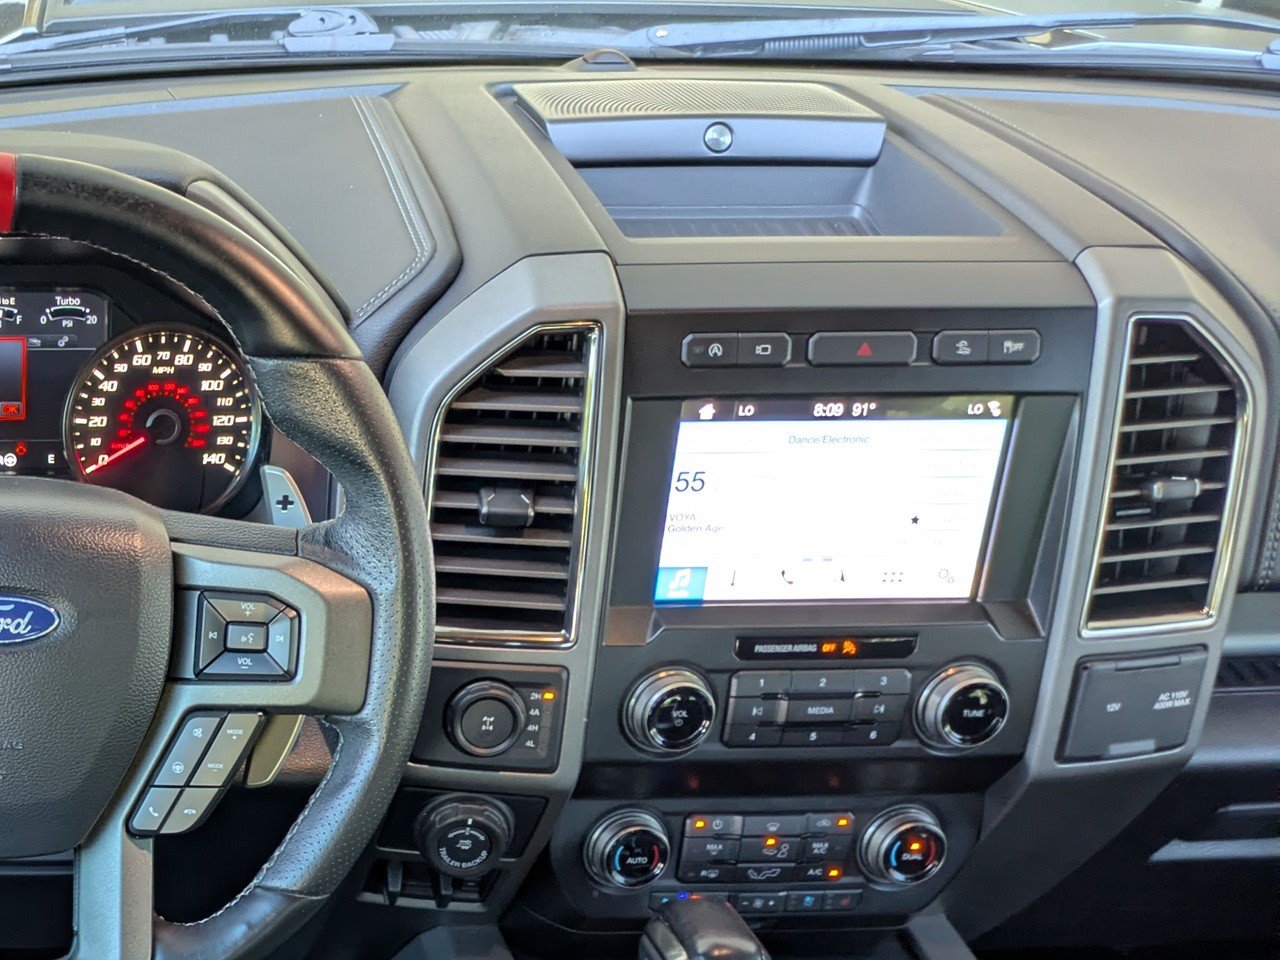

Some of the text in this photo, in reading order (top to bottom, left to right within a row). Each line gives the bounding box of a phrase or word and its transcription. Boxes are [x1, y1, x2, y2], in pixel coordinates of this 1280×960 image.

[2, 297, 9, 305] to
[10, 297, 16, 305] E
[55, 296, 81, 306] Turbo
[16, 315, 23, 324] F
[62, 320, 74, 328] PSI
[86, 315, 98, 324] 20
[132, 354, 151, 366] 60
[156, 351, 170, 360] 70
[174, 354, 194, 365] 80
[114, 363, 128, 373] 50
[152, 366, 174, 374] MPH
[197, 363, 212, 372] 90
[98, 380, 118, 392] 40
[201, 380, 224, 391] 100
[91, 398, 105, 406] 30
[216, 397, 233, 406] 110
[2, 404, 18, 414] OK
[738, 405, 755, 416] LO
[813, 402, 877, 417] 8:09 91°
[967, 404, 984, 415] LO
[88, 416, 107, 427] 20
[212, 415, 234, 426] 120
[90, 437, 101, 446] 10
[216, 436, 233, 445] 130
[48, 454, 55, 464] E
[202, 453, 226, 465] 140
[675, 471, 706, 492] 55
[669, 513, 697, 521] VOYA
[667, 524, 702, 533] Golden
[240, 602, 256, 610] VOL
[754, 644, 793, 653] PASSENGER
[822, 643, 837, 653] OFF
[237, 657, 253, 665] VOL
[758, 679, 764, 687] 1
[819, 678, 827, 687] 2
[880, 676, 888, 685] 3
[530, 692, 541, 700] 2H
[1158, 692, 1170, 701] AC
[1106, 702, 1122, 712] 12V
[1173, 698, 1191, 707] MAX
[529, 708, 540, 716] 4A
[672, 710, 689, 718] VOL
[807, 706, 834, 715] MEDIA
[962, 709, 985, 718] TUNE
[226, 728, 244, 736] MODE
[527, 724, 538, 732] 4H
[748, 733, 756, 741] 4
[809, 732, 817, 741] 5
[869, 730, 877, 739] 6
[525, 740, 535, 748] 4L
[438, 847, 489, 869] TRAILER BACKUP
[626, 856, 648, 864] AUTO
[807, 868, 823, 876] A/C
